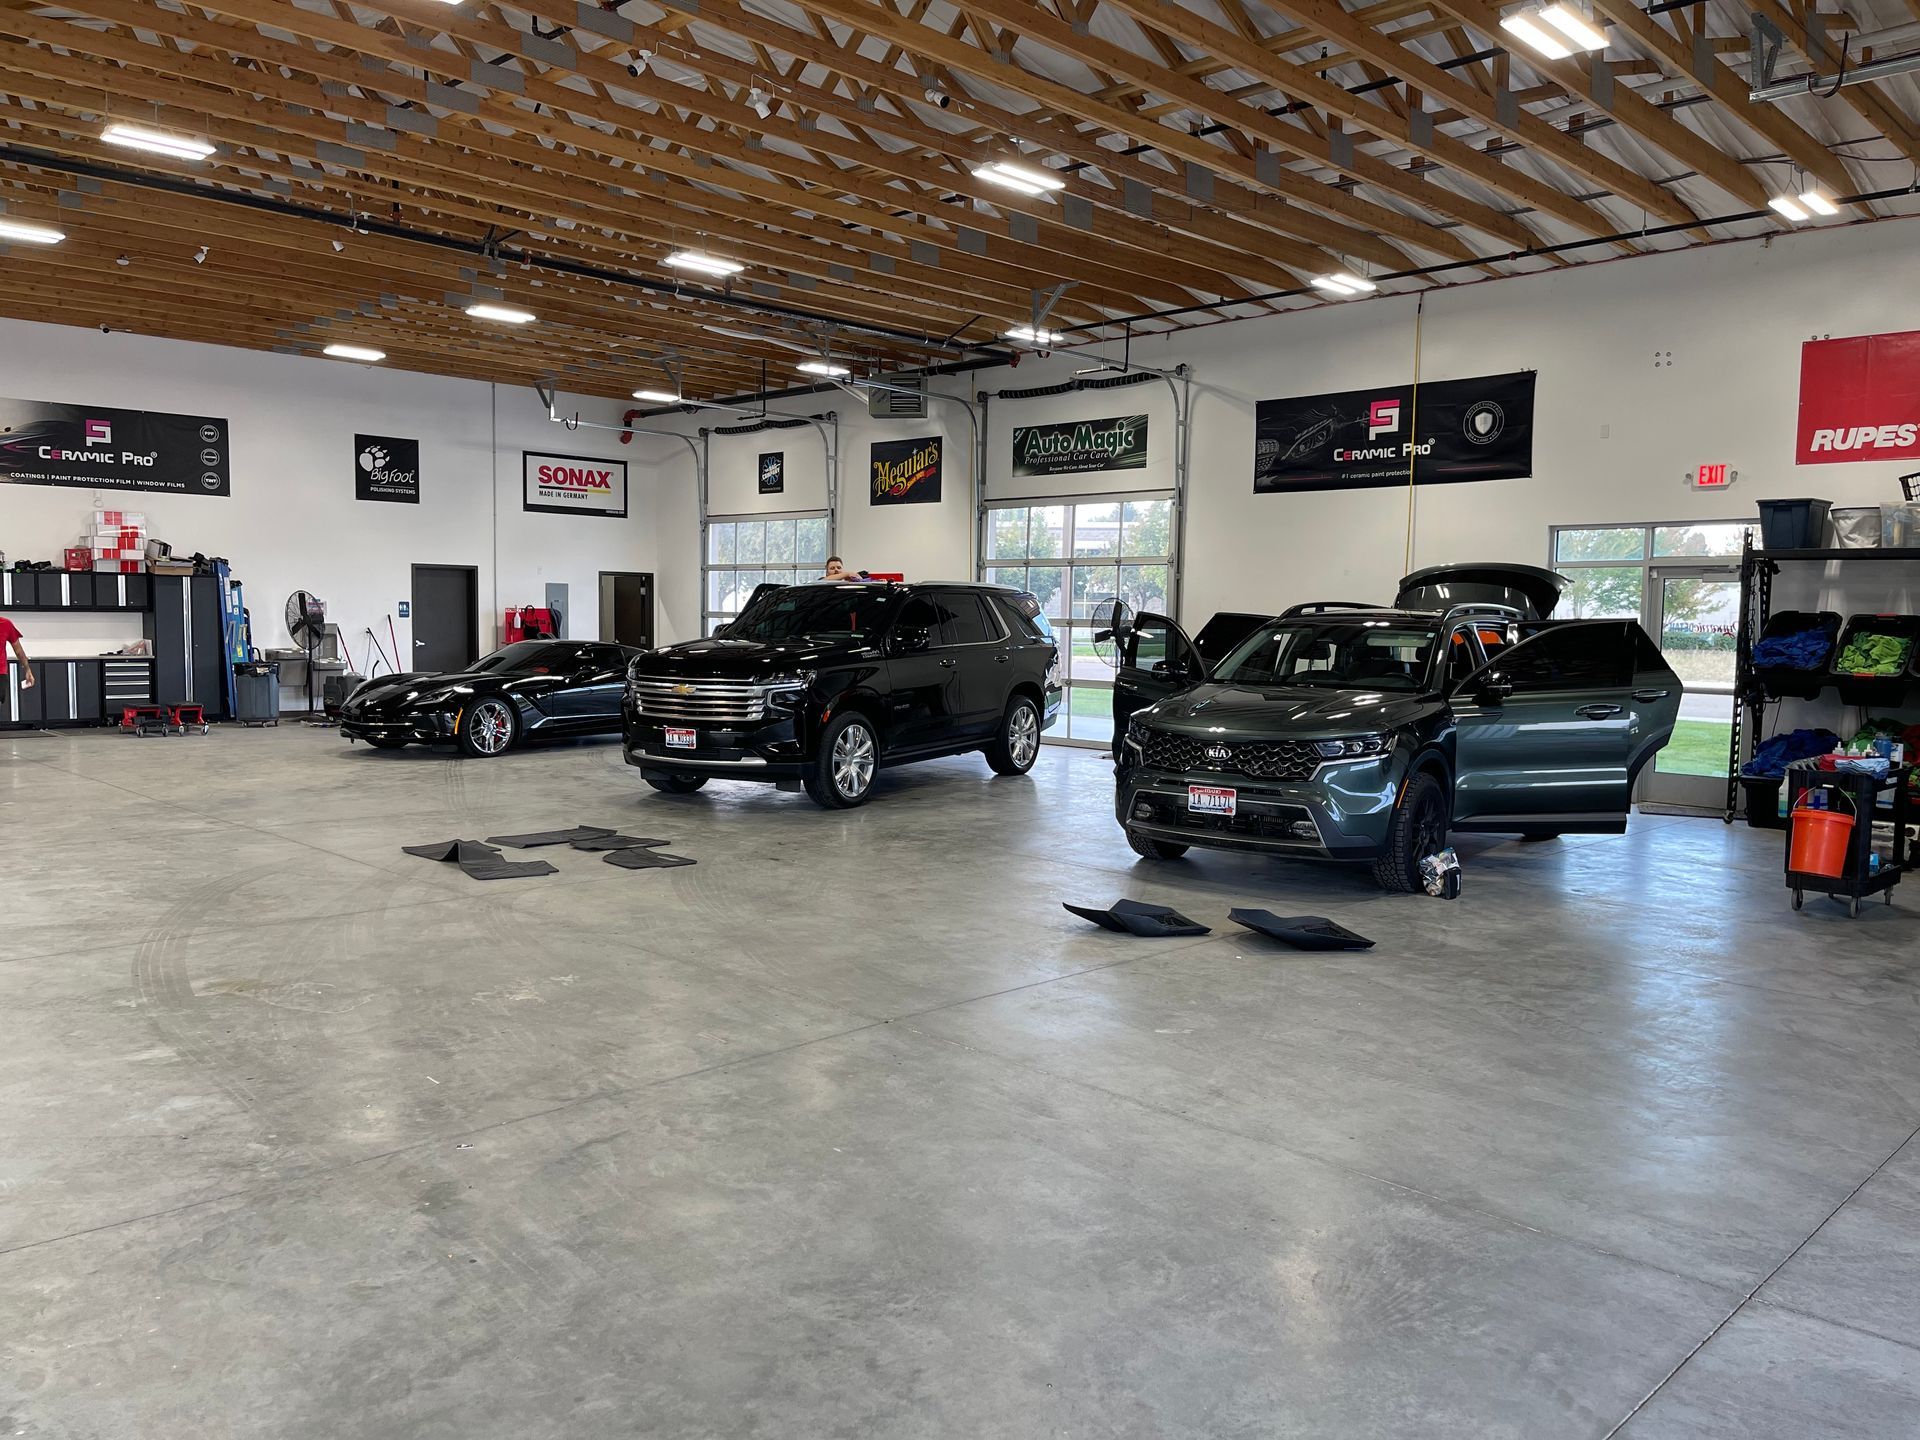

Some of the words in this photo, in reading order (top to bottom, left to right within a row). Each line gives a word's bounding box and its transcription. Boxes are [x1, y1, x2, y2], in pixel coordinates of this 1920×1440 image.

[1810, 424, 1918, 452] RUPES
[38, 445, 114, 464] CERAMIC
[1024, 452, 1072, 465] Professional
[1073, 452, 1087, 460] Car
[1090, 450, 1109, 459] Care
[1333, 447, 1396, 462] CERAMIC
[538, 465, 612, 489] SONAX
[872, 441, 939, 498] Meguiar's
[1385, 469, 1411, 478] protectio
[1698, 464, 1727, 485] EXIT
[10, 471, 46, 480] COATINGS
[51, 474, 71, 482] PAINT
[72, 475, 115, 485] PROTECTION
[116, 476, 131, 485] FILM
[370, 486, 394, 494] POLISHING
[395, 487, 416, 496] SYSTEMS
[538, 490, 553, 498] MADE
[562, 492, 588, 500] GERMANY
[1208, 748, 1227, 758] KIA
[1192, 793, 1202, 805] 1A
